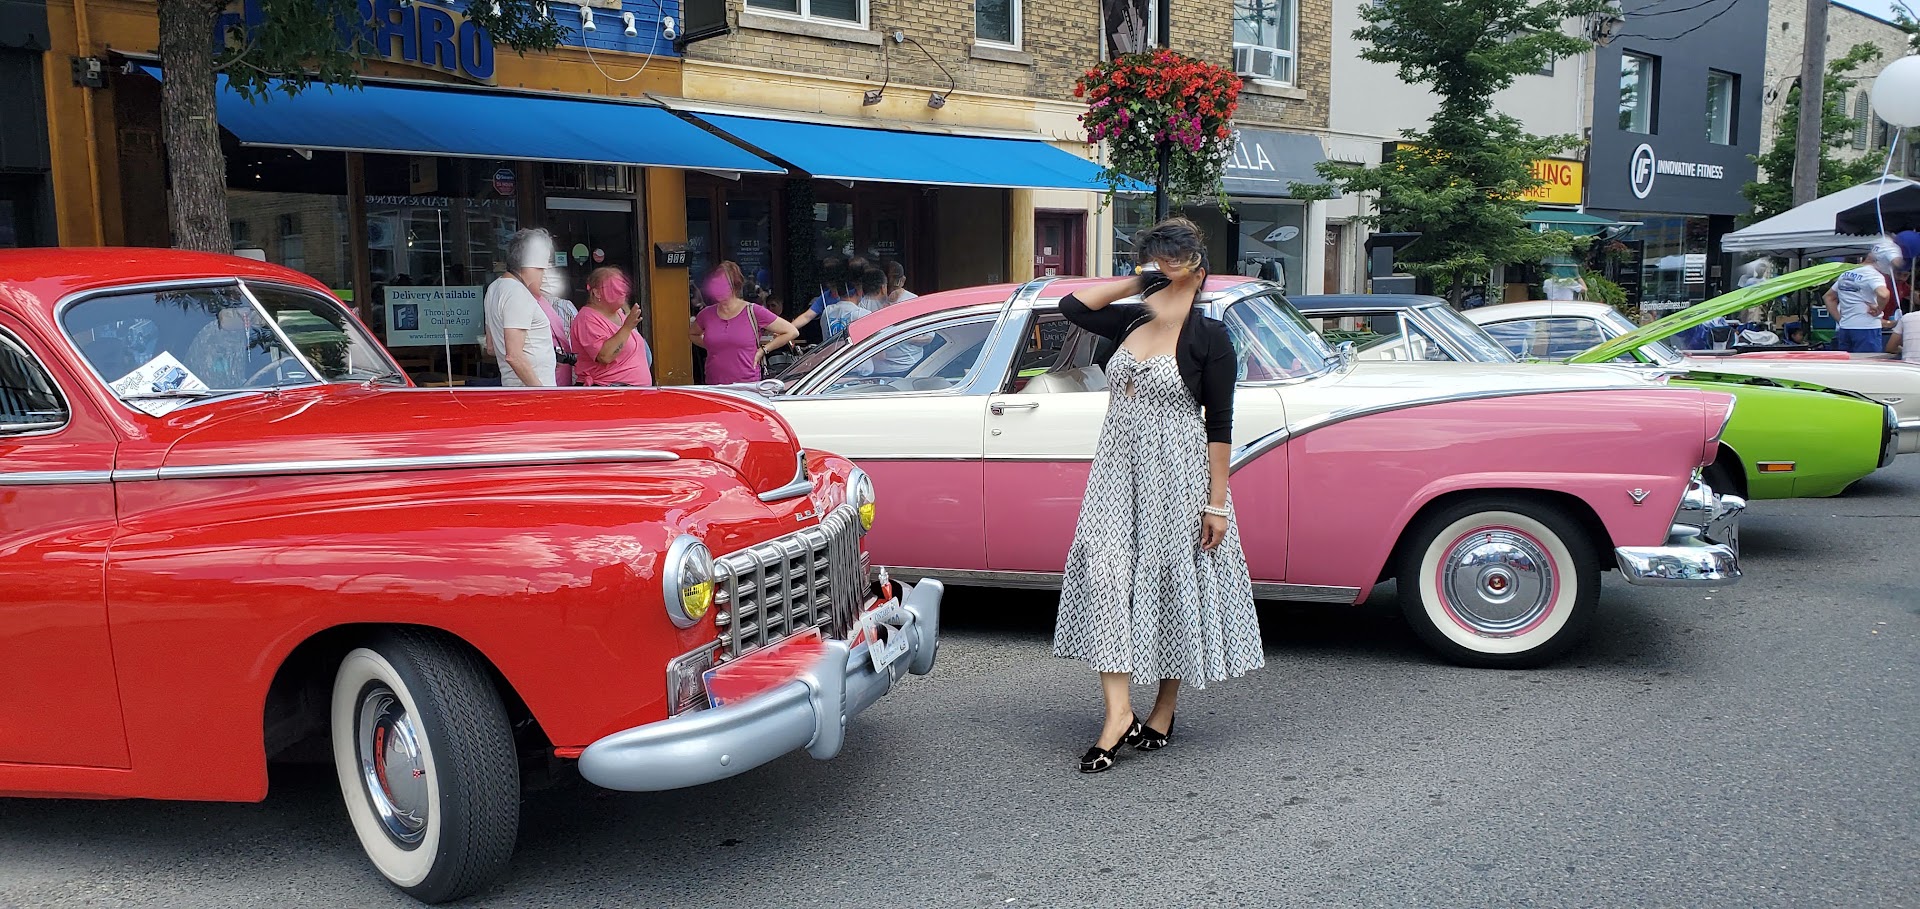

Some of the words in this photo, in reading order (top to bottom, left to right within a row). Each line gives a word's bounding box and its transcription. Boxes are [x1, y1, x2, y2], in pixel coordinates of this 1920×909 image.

[1226, 142, 1275, 171] LLA
[1636, 158, 1650, 183] IF
[1657, 160, 1695, 177] INNOVATIVE
[1697, 164, 1724, 179] FITNESS
[1512, 186, 1551, 198] ARKET
[667, 253, 685, 263] 502
[392, 291, 431, 301] Delivery
[433, 291, 476, 299] Available
[423, 309, 455, 317] Through
[456, 308, 470, 316] Our
[430, 317, 455, 325] Onlne
[456, 317, 470, 326] App
